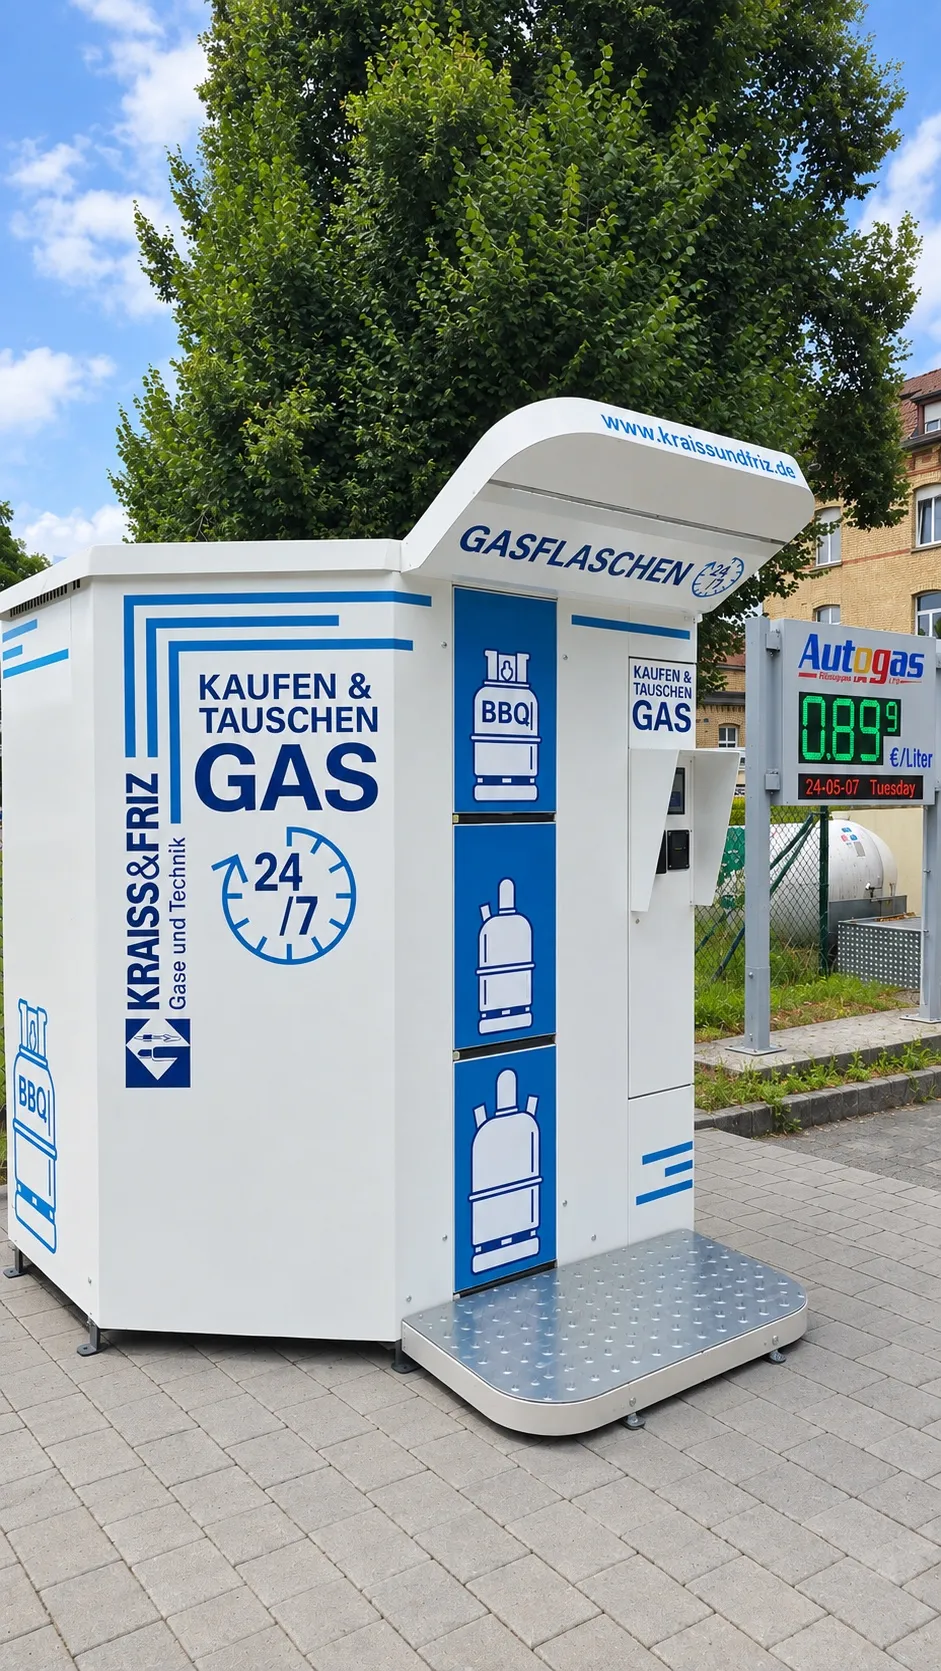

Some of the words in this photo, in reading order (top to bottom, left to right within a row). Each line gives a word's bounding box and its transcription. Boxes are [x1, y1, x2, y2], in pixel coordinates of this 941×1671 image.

[601, 413, 796, 479] www.kraissundfriz.de
[459, 525, 694, 586] GASFLASCHEN
[709, 564, 731, 578] 24
[633, 665, 681, 683] KAUFEN
[683, 670, 692, 684] &
[798, 633, 925, 685] Autogas
[199, 673, 337, 701] KAUFEN
[348, 672, 372, 700] &
[633, 682, 692, 700] TAUSCHEN
[199, 706, 379, 734] TAUSCHEN
[482, 700, 530, 727] BBQ
[632, 699, 692, 733] GAS
[889, 747, 933, 769] €/Liter
[194, 742, 379, 813] GAS
[805, 778, 860, 795] 24-05-07
[869, 779, 916, 798] Tuesday
[168, 837, 187, 912] Technik
[254, 852, 303, 892] 24
[126, 773, 159, 1010] KRAISS&FRIZ
[279, 896, 318, 937] /7
[169, 918, 187, 954] und
[169, 961, 187, 1010] Gase
[18, 1075, 47, 1123] BBQ
